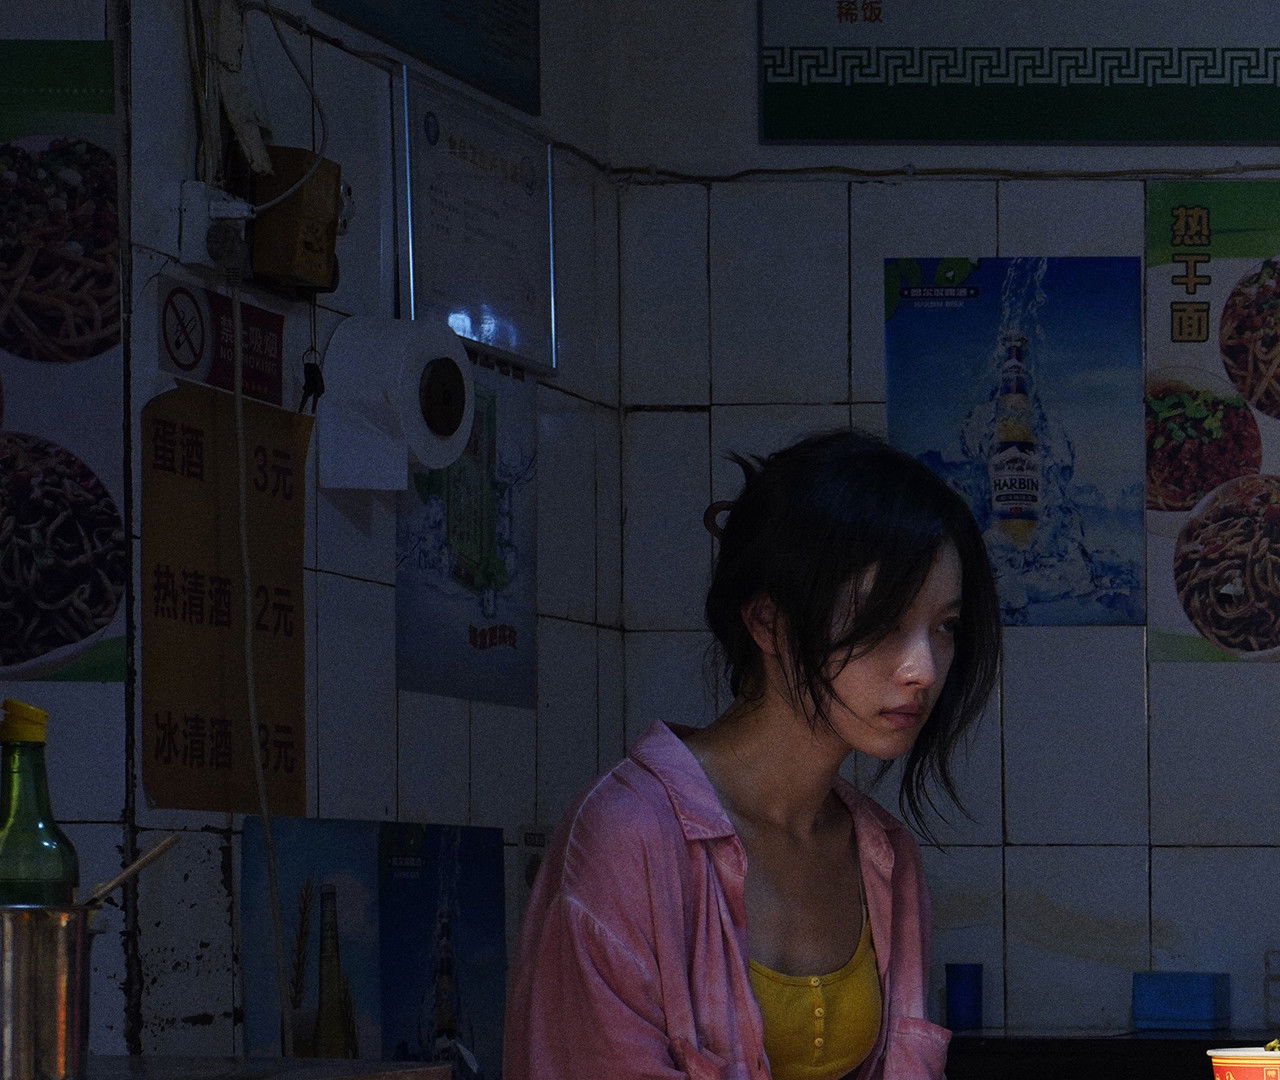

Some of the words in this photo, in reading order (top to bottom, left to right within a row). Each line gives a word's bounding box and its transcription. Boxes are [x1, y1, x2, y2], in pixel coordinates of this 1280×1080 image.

[1171, 205, 1211, 343] 热干面
[151, 419, 205, 482] 蛋酒
[253, 445, 294, 501] 3元
[993, 477, 1039, 492] HARBIN
[152, 563, 233, 630] 热清酒
[255, 586, 295, 638] 2元
[152, 711, 234, 771] 冰清酒
[257, 722, 298, 774] 3元
